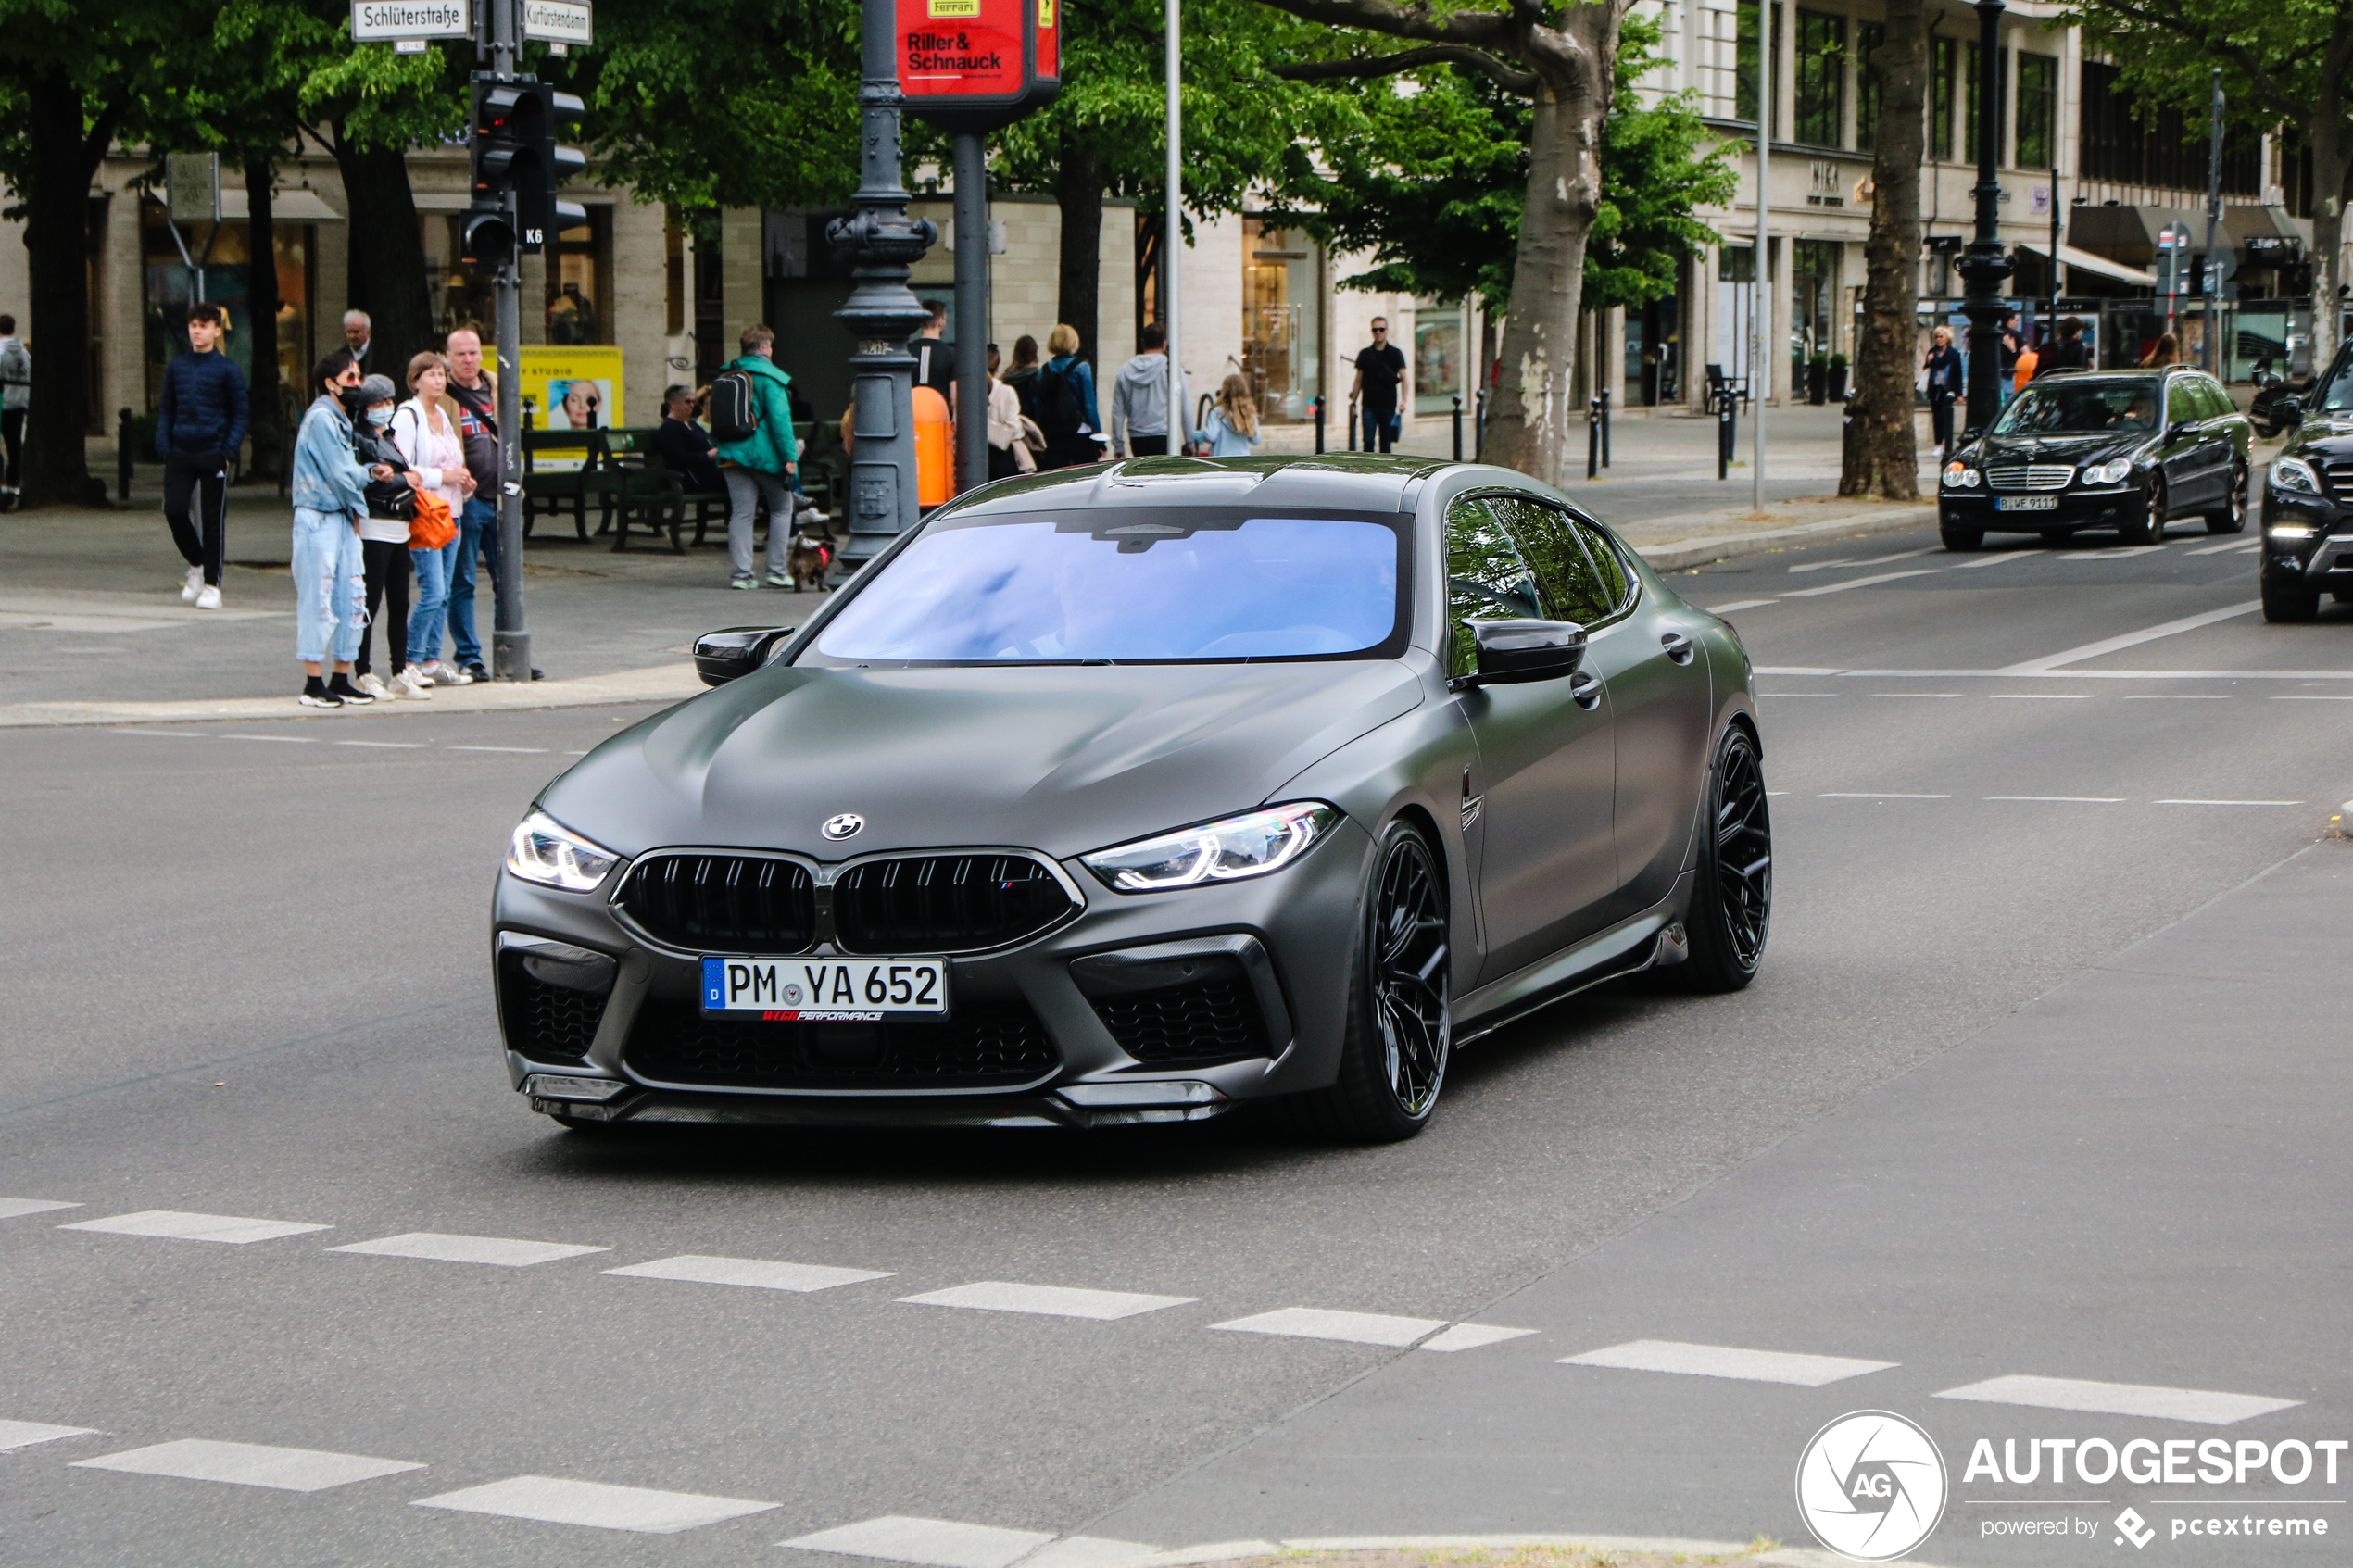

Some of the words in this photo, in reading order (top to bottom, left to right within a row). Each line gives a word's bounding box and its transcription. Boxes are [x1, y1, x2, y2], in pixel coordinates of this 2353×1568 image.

[934, 2, 974, 12] Ferrari
[364, 4, 459, 29] Schlüterstraße
[525, 4, 587, 31] Kurfürstendamm
[907, 33, 954, 51] Riller
[956, 32, 970, 51] &
[908, 52, 1000, 70] Schnauck
[526, 228, 543, 244] K6
[2001, 498, 2007, 509] B
[2014, 498, 2027, 509] WE
[2030, 497, 2057, 509] 9111
[727, 964, 776, 1003] PM
[804, 965, 854, 1004] YA
[865, 966, 938, 1005] 652
